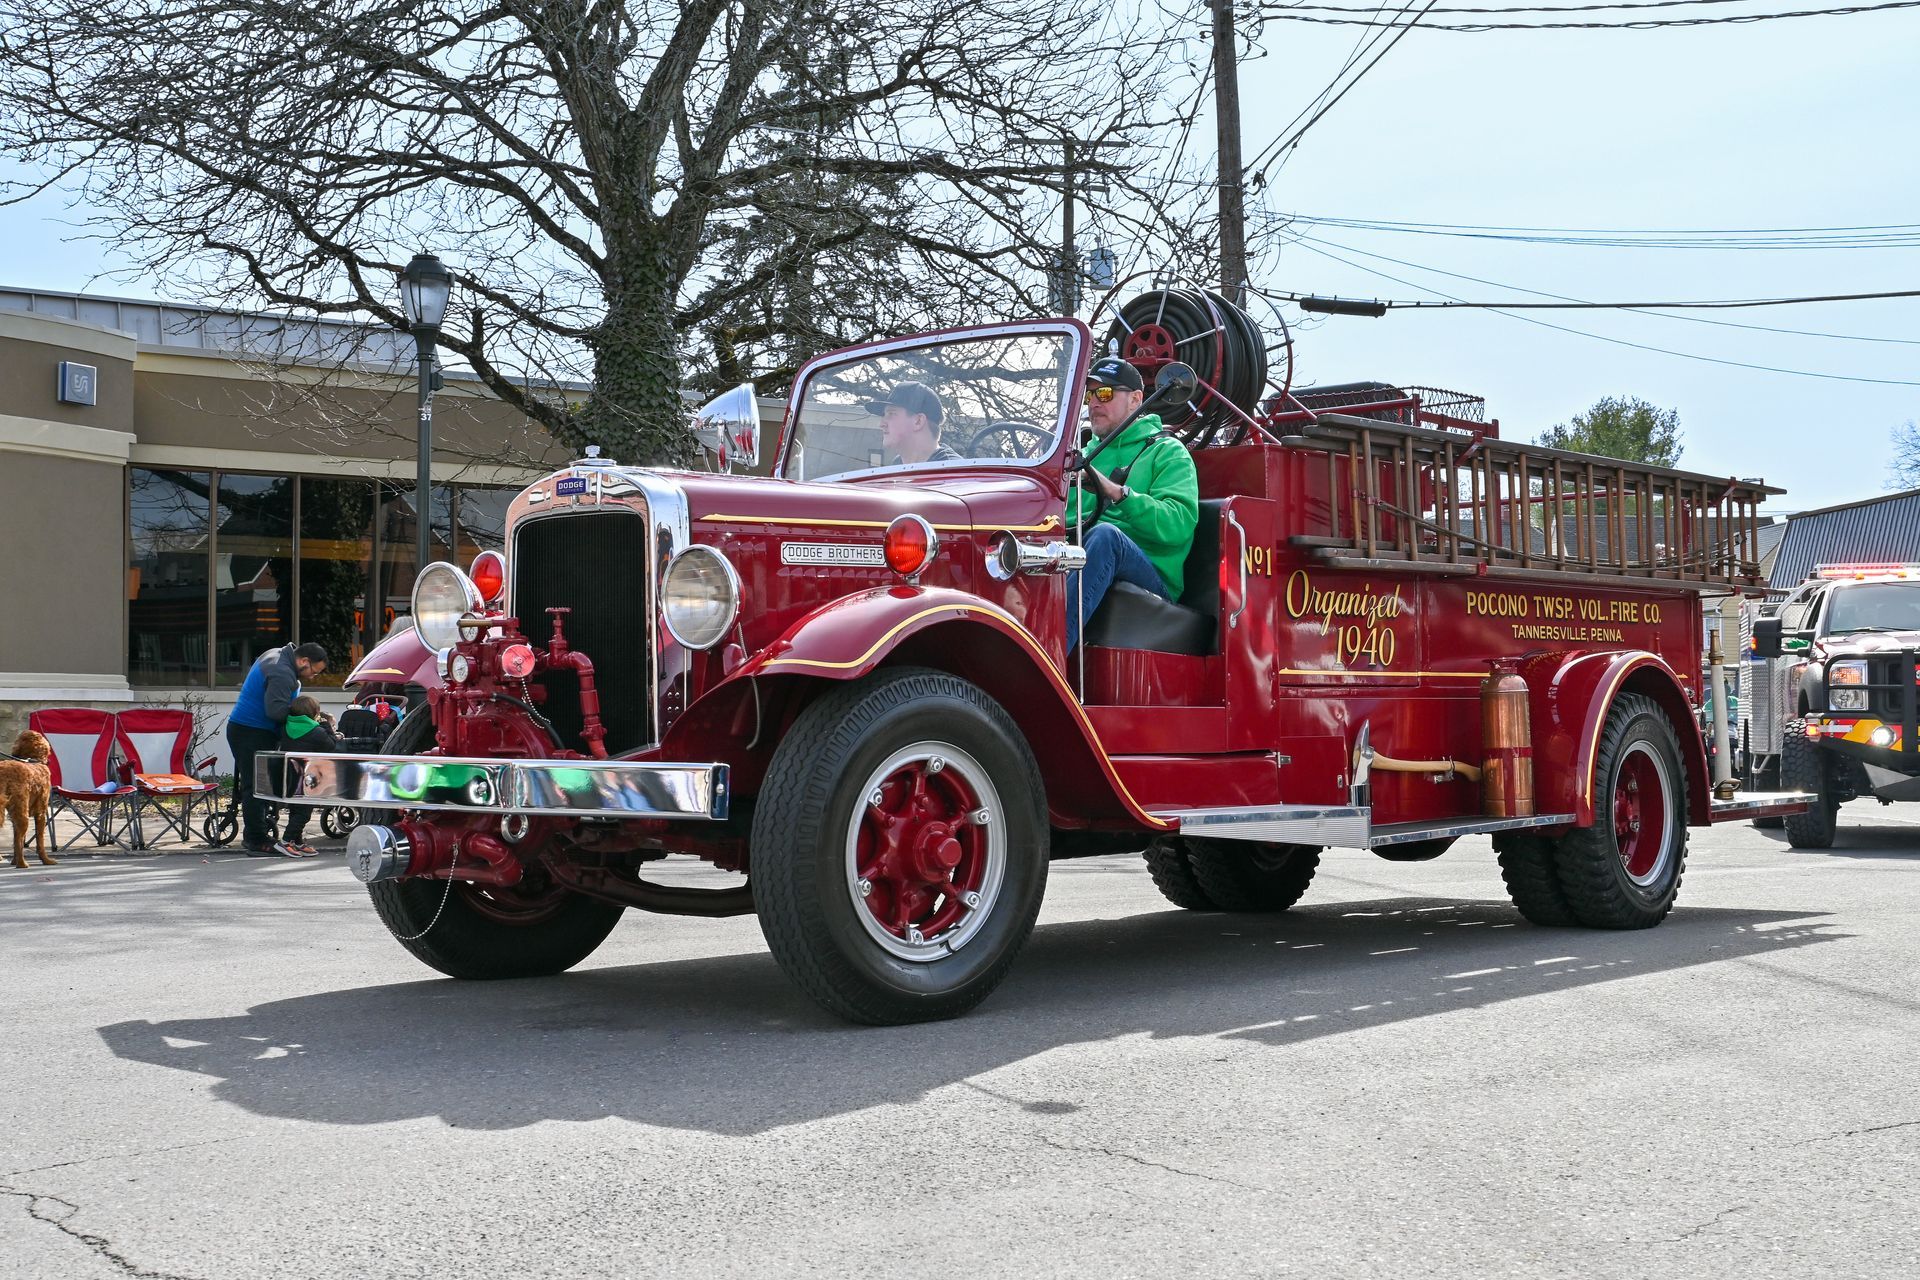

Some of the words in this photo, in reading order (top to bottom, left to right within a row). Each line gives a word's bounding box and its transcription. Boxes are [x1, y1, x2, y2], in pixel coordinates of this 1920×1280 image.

[420, 413, 432, 421] 37
[558, 481, 584, 490] DODGE
[788, 546, 823, 558] DODGE
[828, 548, 883, 560] BROTHERS
[1286, 569, 1402, 636] Organized
[1467, 591, 1528, 617] POCONO
[1533, 596, 1575, 620] TWSP.
[1578, 599, 1609, 621] VOL.
[1610, 601, 1639, 622] FIRE
[1643, 603, 1662, 624] CO.
[1512, 624, 1589, 642] TANNERSVILLE,
[1591, 627, 1625, 642] PENNA.
[1336, 625, 1395, 667] 1940
